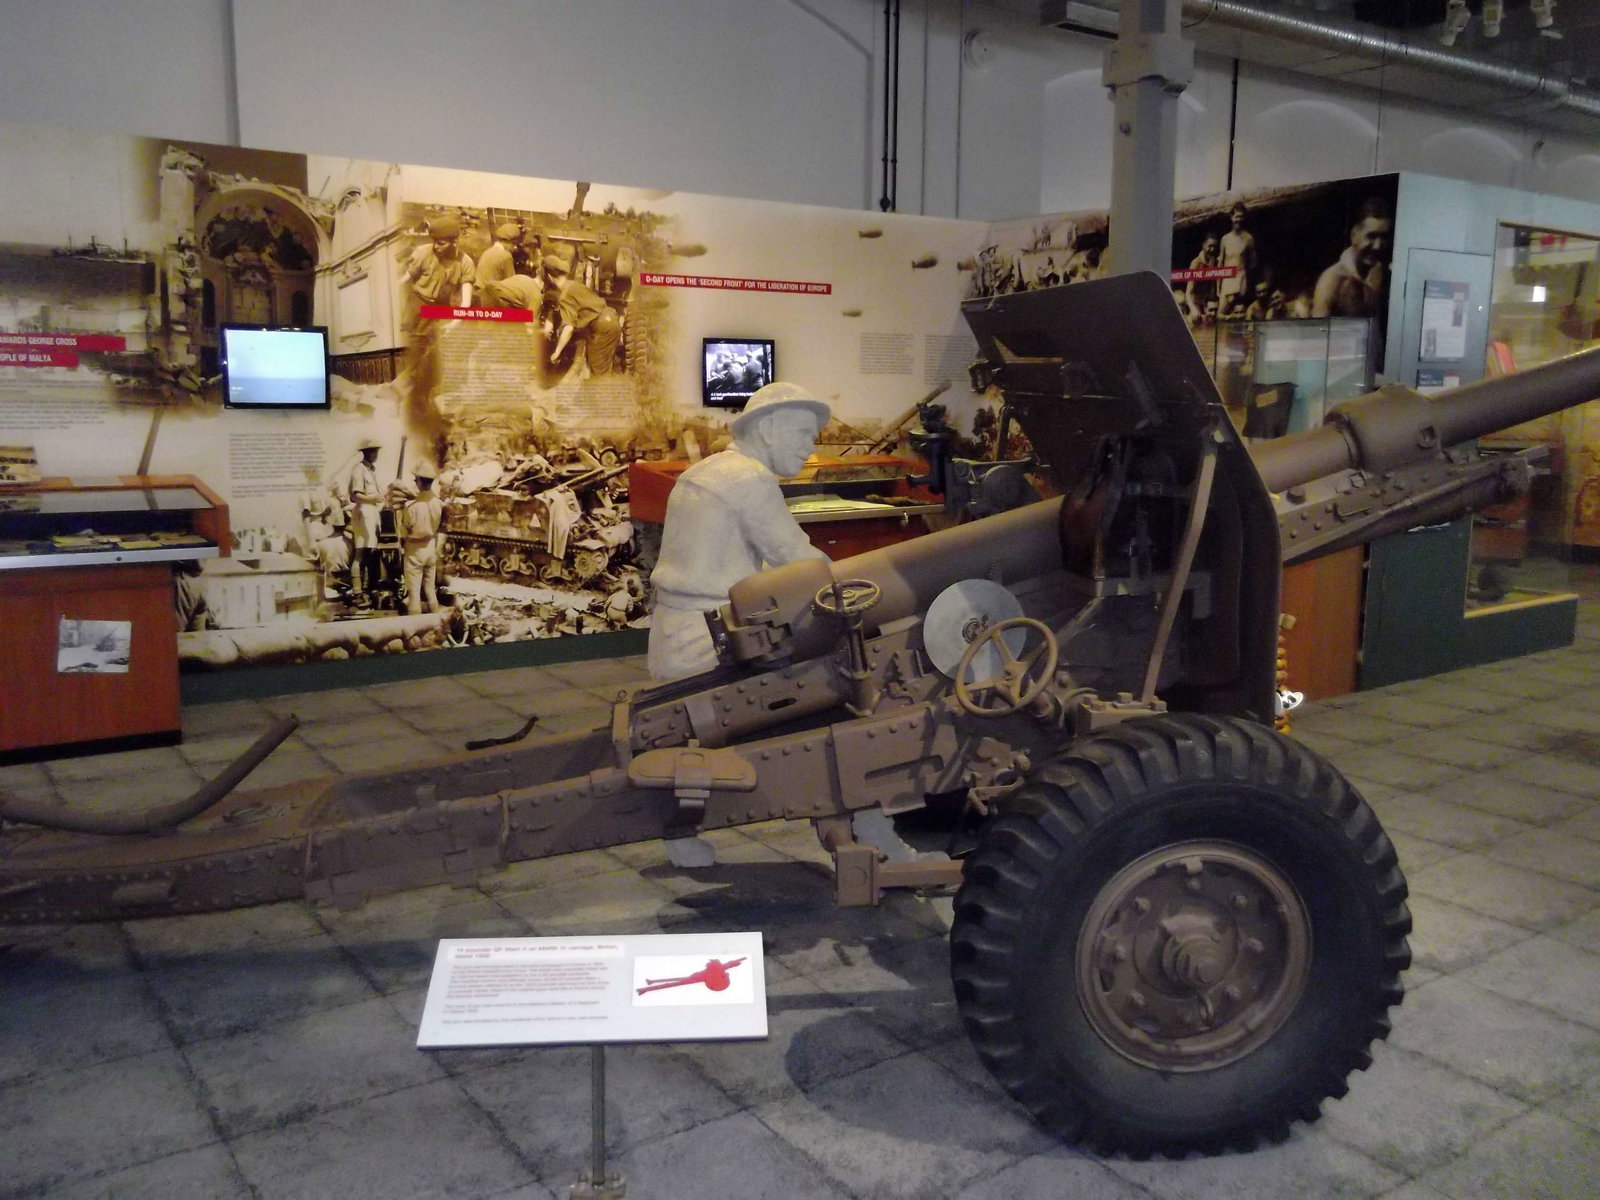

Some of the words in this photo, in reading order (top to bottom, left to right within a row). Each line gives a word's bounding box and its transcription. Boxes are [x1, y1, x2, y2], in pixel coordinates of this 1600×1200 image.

[1184, 271, 1191, 279] OF
[1192, 270, 1203, 278] THE
[1204, 268, 1232, 277] JAPANESE
[645, 275, 664, 283] D-DAY
[665, 276, 685, 285] OPENS
[686, 277, 697, 285] THE
[745, 280, 755, 288] FOR
[757, 281, 767, 289] THE
[768, 282, 798, 291] LIBERATION
[807, 284, 827, 293] EUROPE
[453, 309, 475, 318] RUN-IN
[475, 310, 484, 318] TO
[484, 310, 503, 319] D-DAY
[28, 336, 55, 345] GEORGE
[55, 337, 77, 346] CROSS
[0, 353, 17, 361] OPLE
[18, 353, 27, 362] OF
[28, 354, 52, 362] MALTA
